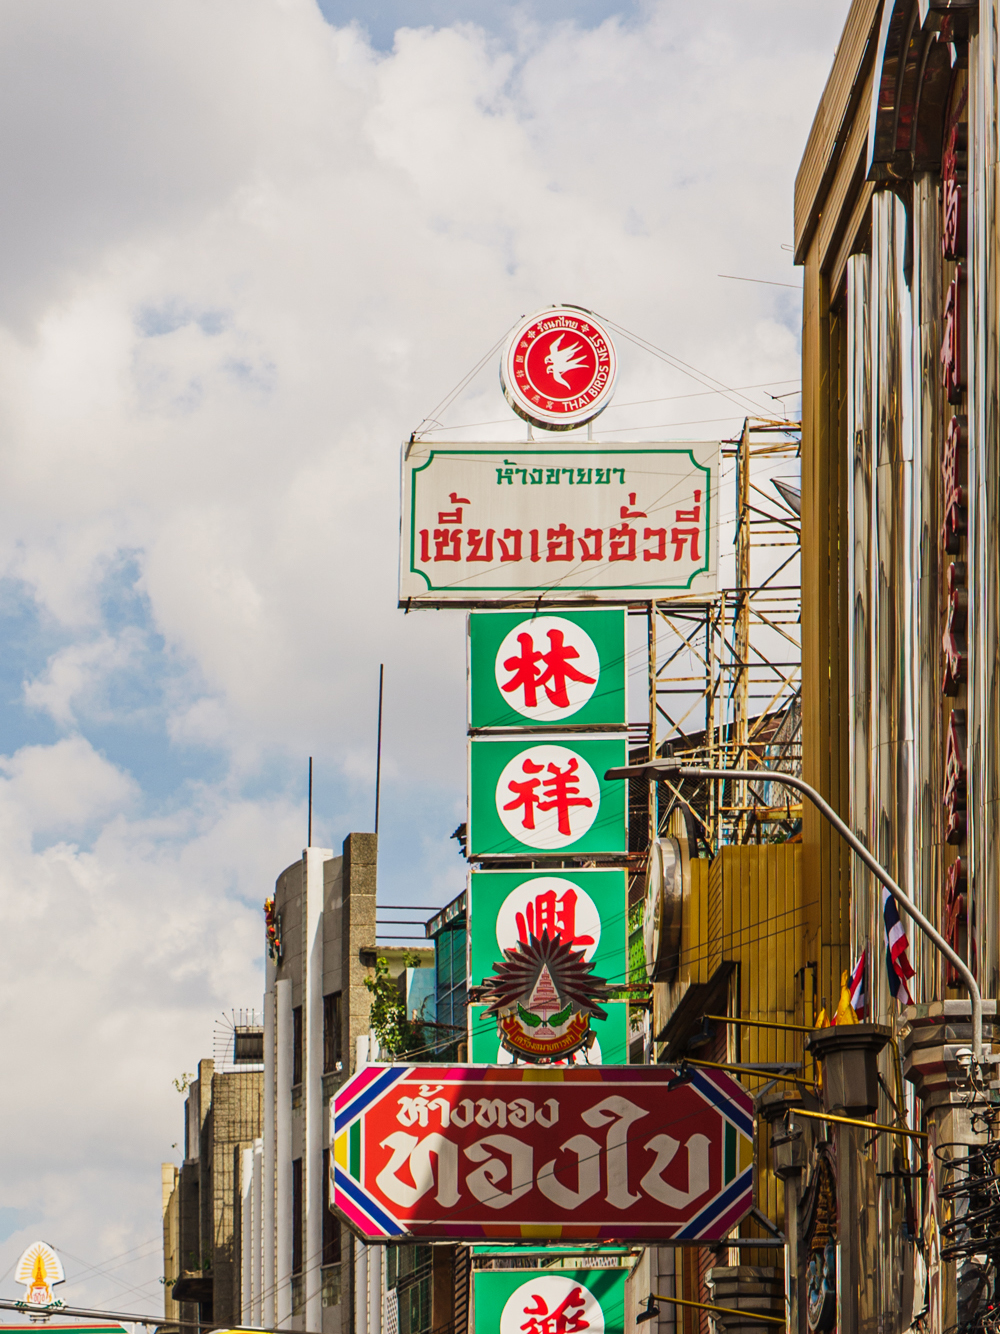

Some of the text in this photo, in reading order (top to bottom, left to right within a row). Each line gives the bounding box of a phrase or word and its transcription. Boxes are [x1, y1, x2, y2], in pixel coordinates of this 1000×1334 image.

[537, 316, 579, 332] รังนกไทย
[562, 333, 610, 411] THAI BIRDS NEST
[496, 459, 626, 486] ห้างขายยา
[395, 1084, 560, 1128] ห้างทอง
[375, 1095, 712, 1210] ทองใบ
